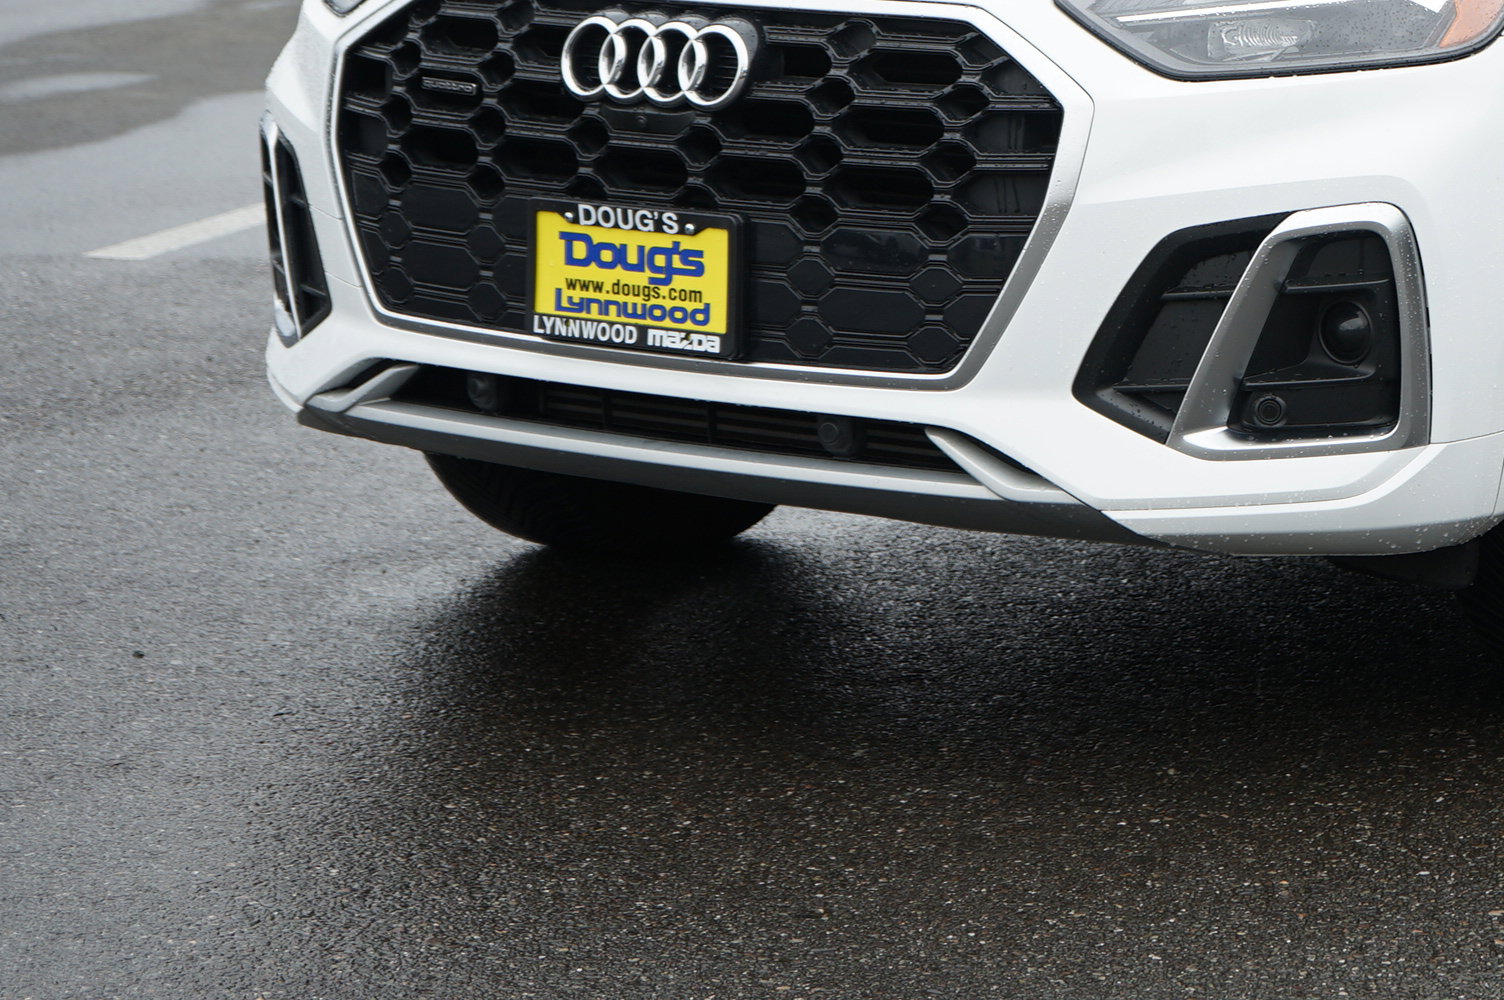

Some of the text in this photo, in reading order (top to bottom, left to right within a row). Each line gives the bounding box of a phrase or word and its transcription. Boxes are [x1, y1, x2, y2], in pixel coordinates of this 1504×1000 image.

[577, 204, 680, 235] DOUG'S
[565, 277, 703, 304] www.dougs.com
[554, 287, 711, 327] Lynnwood
[532, 314, 638, 345] LYNNWOOD
